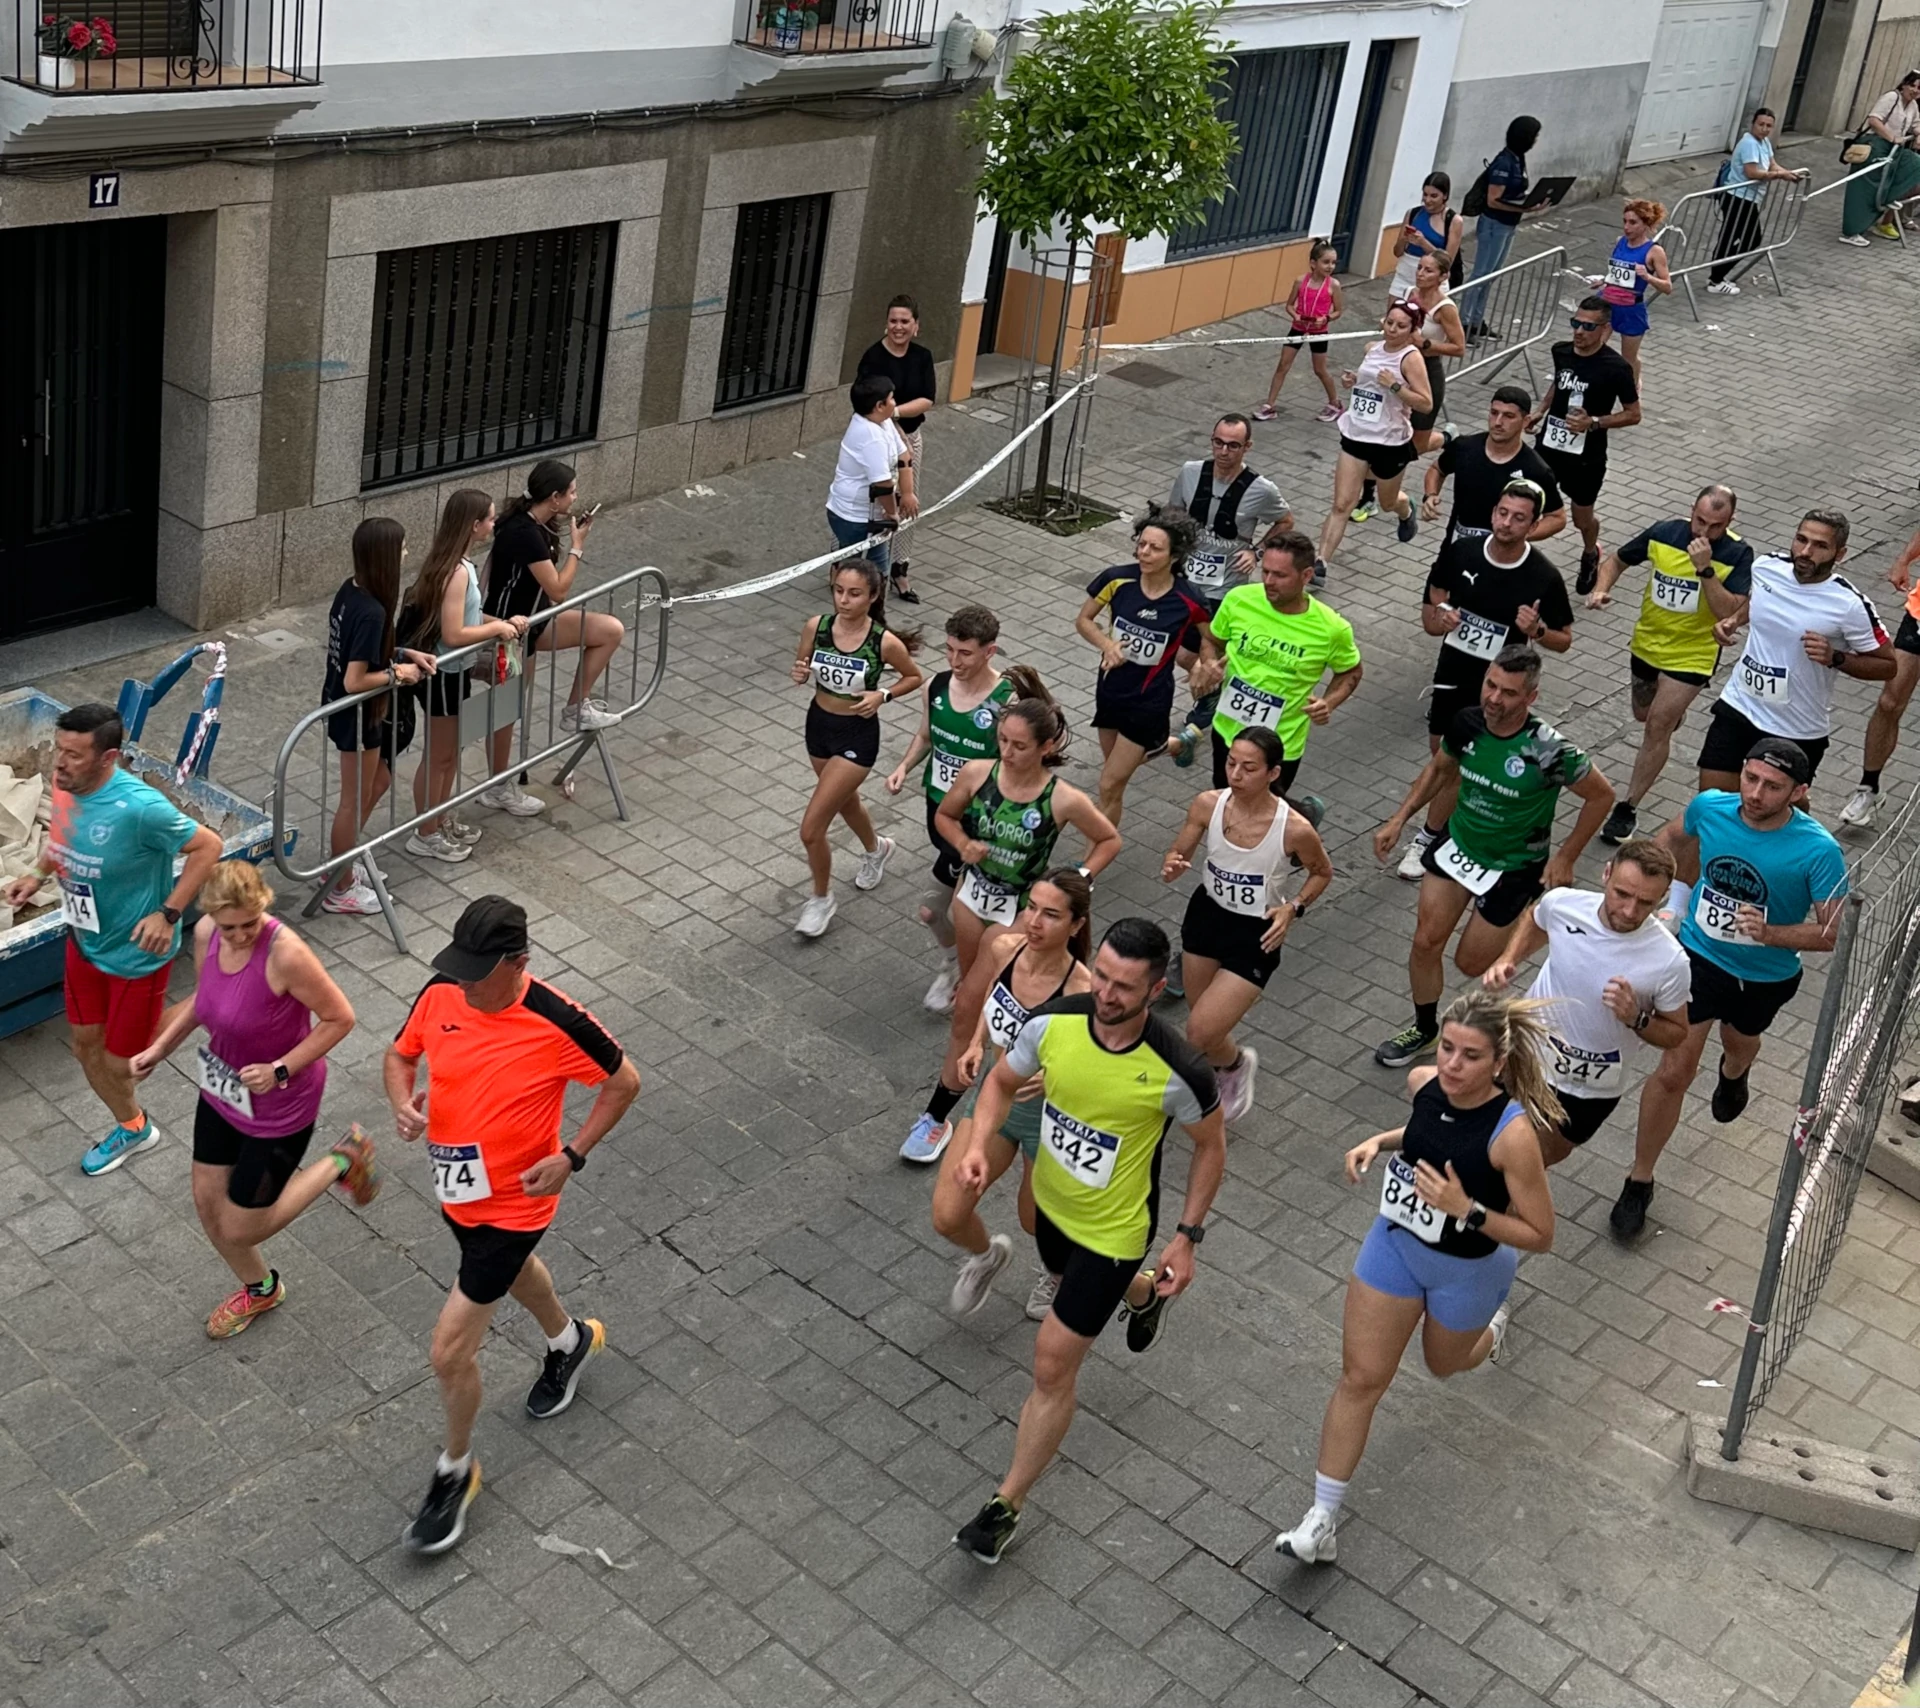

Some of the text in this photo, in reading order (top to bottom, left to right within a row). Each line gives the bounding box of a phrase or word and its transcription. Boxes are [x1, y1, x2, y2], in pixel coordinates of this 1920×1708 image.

[94, 177, 117, 205] 17
[1353, 397, 1377, 415] 838
[1551, 428, 1580, 446] 837
[1188, 558, 1218, 578] 822
[1660, 574, 1689, 588] CORIA
[1657, 583, 1692, 605] 817
[1125, 624, 1156, 640] CORIA
[1466, 614, 1496, 632] CORIA
[1458, 624, 1494, 650] 821
[824, 655, 854, 668] CORIA
[1748, 660, 1775, 675] CORIA
[820, 666, 856, 687] 867
[1745, 669, 1775, 695] 901
[1240, 684, 1273, 704] CORIA
[1231, 693, 1271, 723] 841
[941, 754, 964, 767] CORI
[940, 764, 960, 785] 85
[1492, 783, 1520, 798] CORIA
[978, 815, 1034, 847] CHORRO
[1215, 868, 1251, 883] CORIA
[972, 882, 1008, 913] 912
[1213, 877, 1255, 906] 818
[1712, 894, 1739, 913] CORI
[1706, 905, 1736, 933] 82
[1001, 995, 1026, 1021] CORI
[991, 1007, 1017, 1041] 84
[1562, 1044, 1606, 1062] CORIA
[1555, 1055, 1611, 1080] 847
[1057, 1113, 1102, 1144] CORIA
[430, 1146, 463, 1158] ORIA
[1051, 1126, 1103, 1174] 842
[1385, 1178, 1434, 1227] 845
